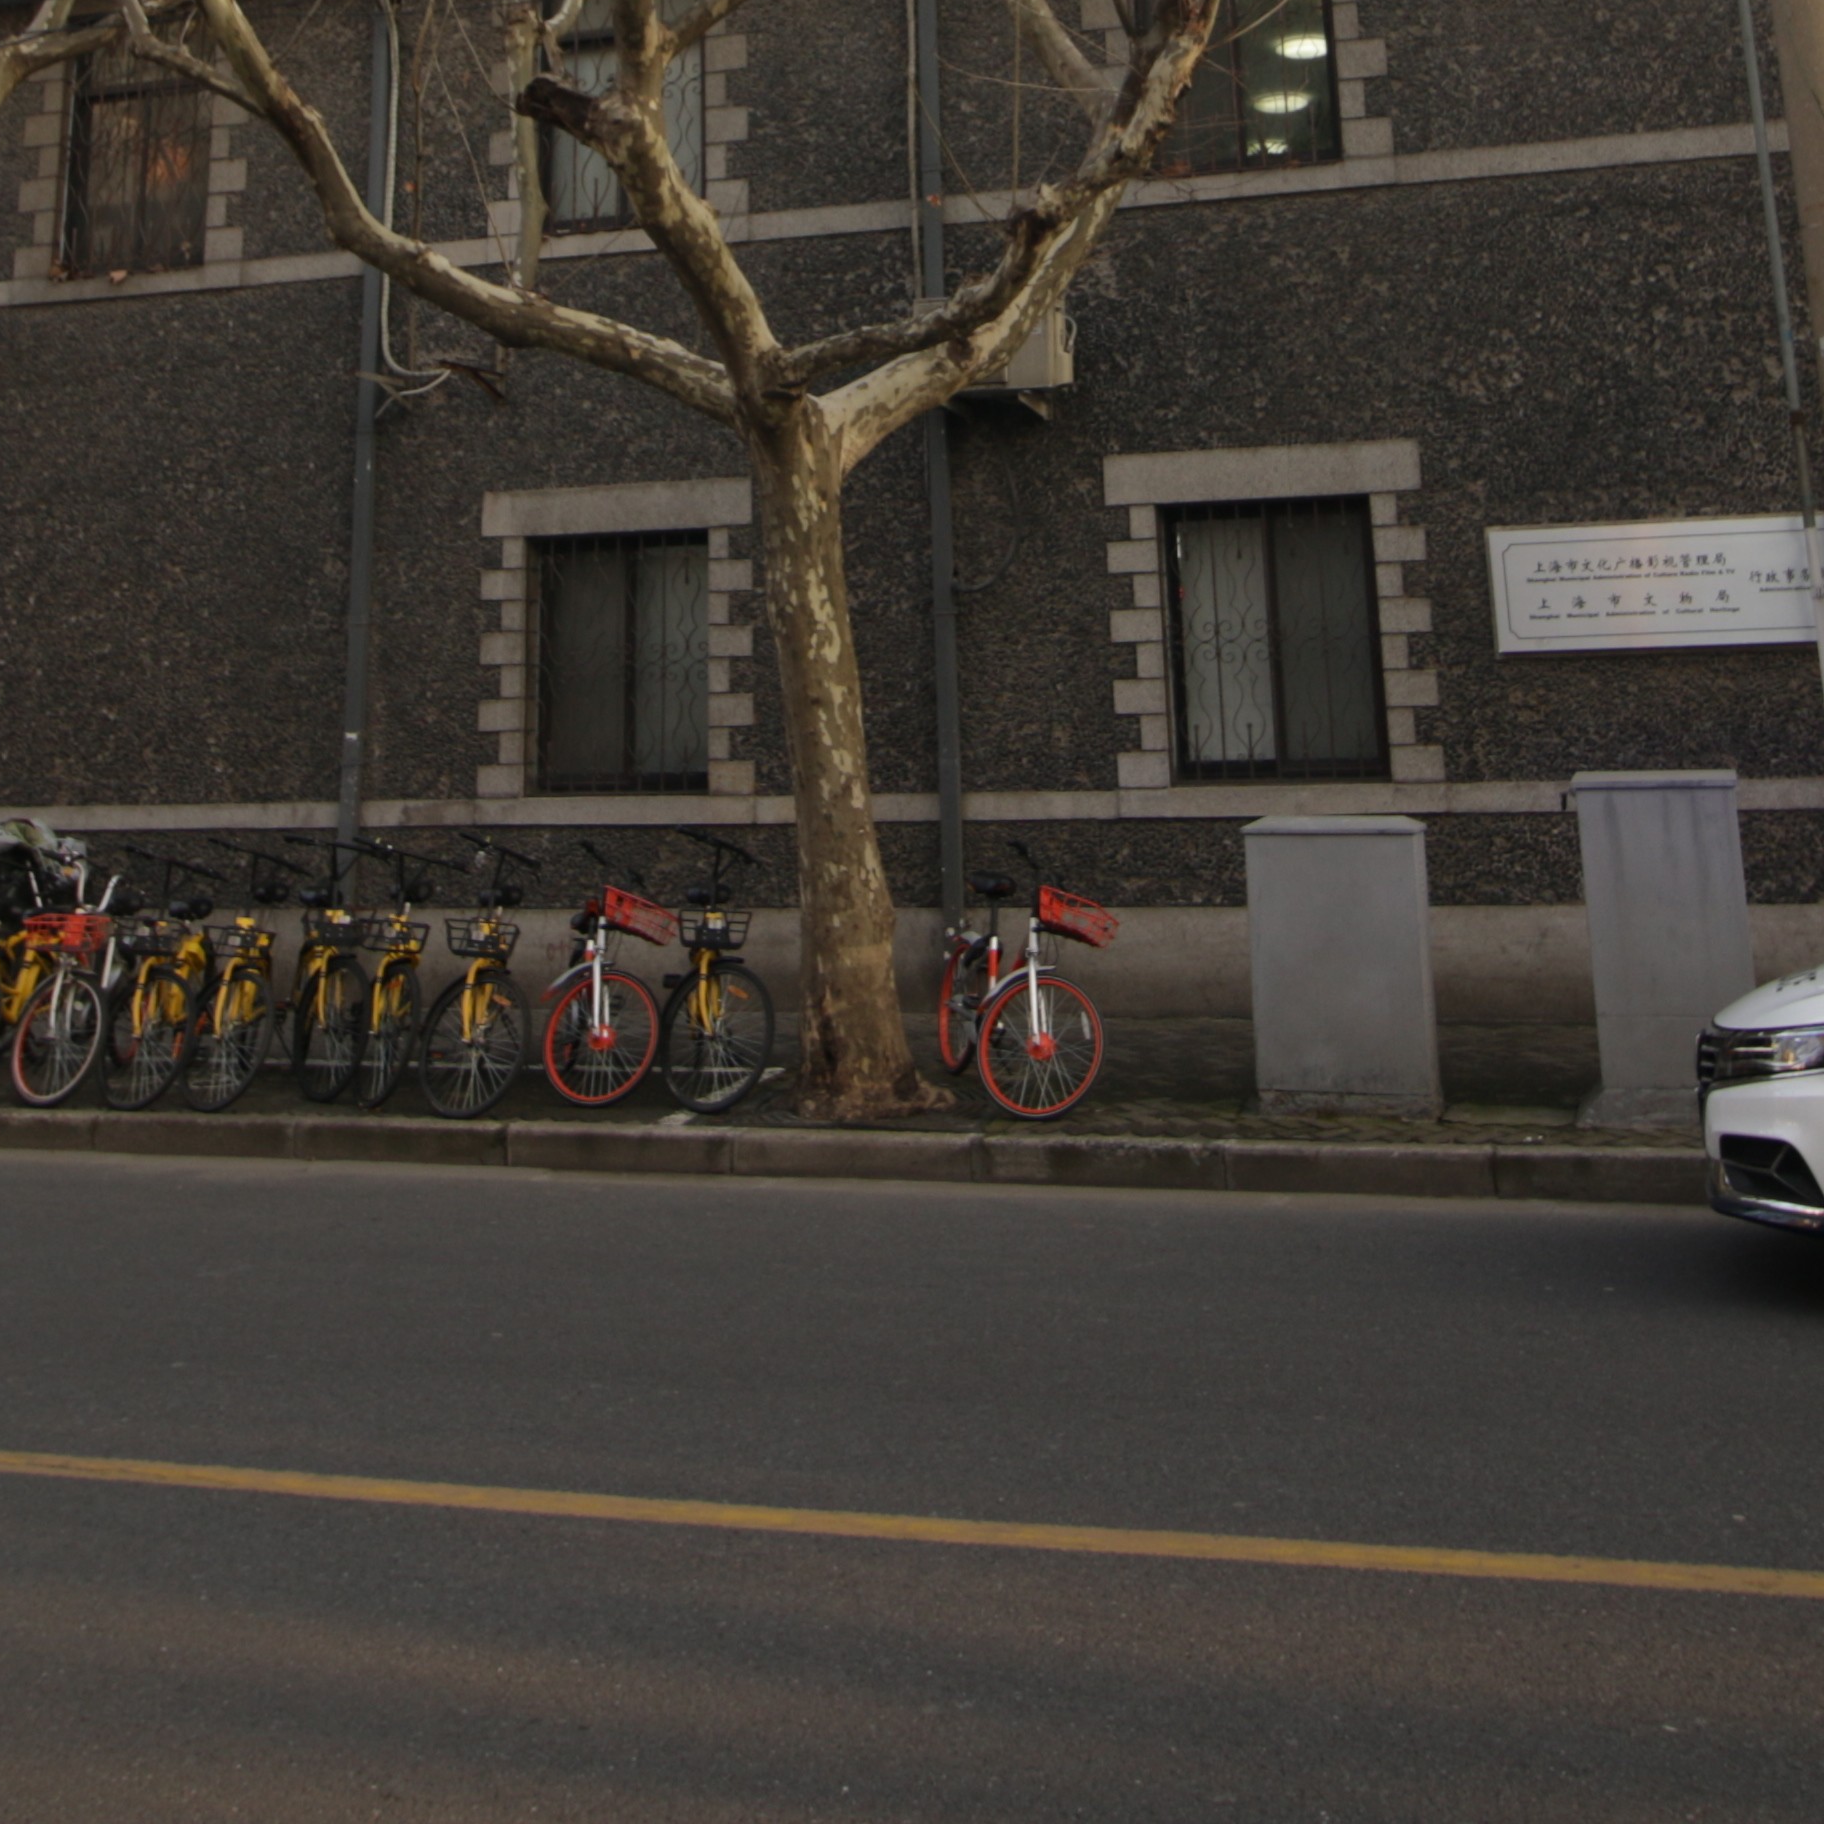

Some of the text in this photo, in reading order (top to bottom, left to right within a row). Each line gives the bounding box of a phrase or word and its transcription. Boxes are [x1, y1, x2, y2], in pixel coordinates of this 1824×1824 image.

[1533, 552, 1726, 573] 上海市文化广播影视管理局
[1537, 589, 1730, 610] 上海市文物局
